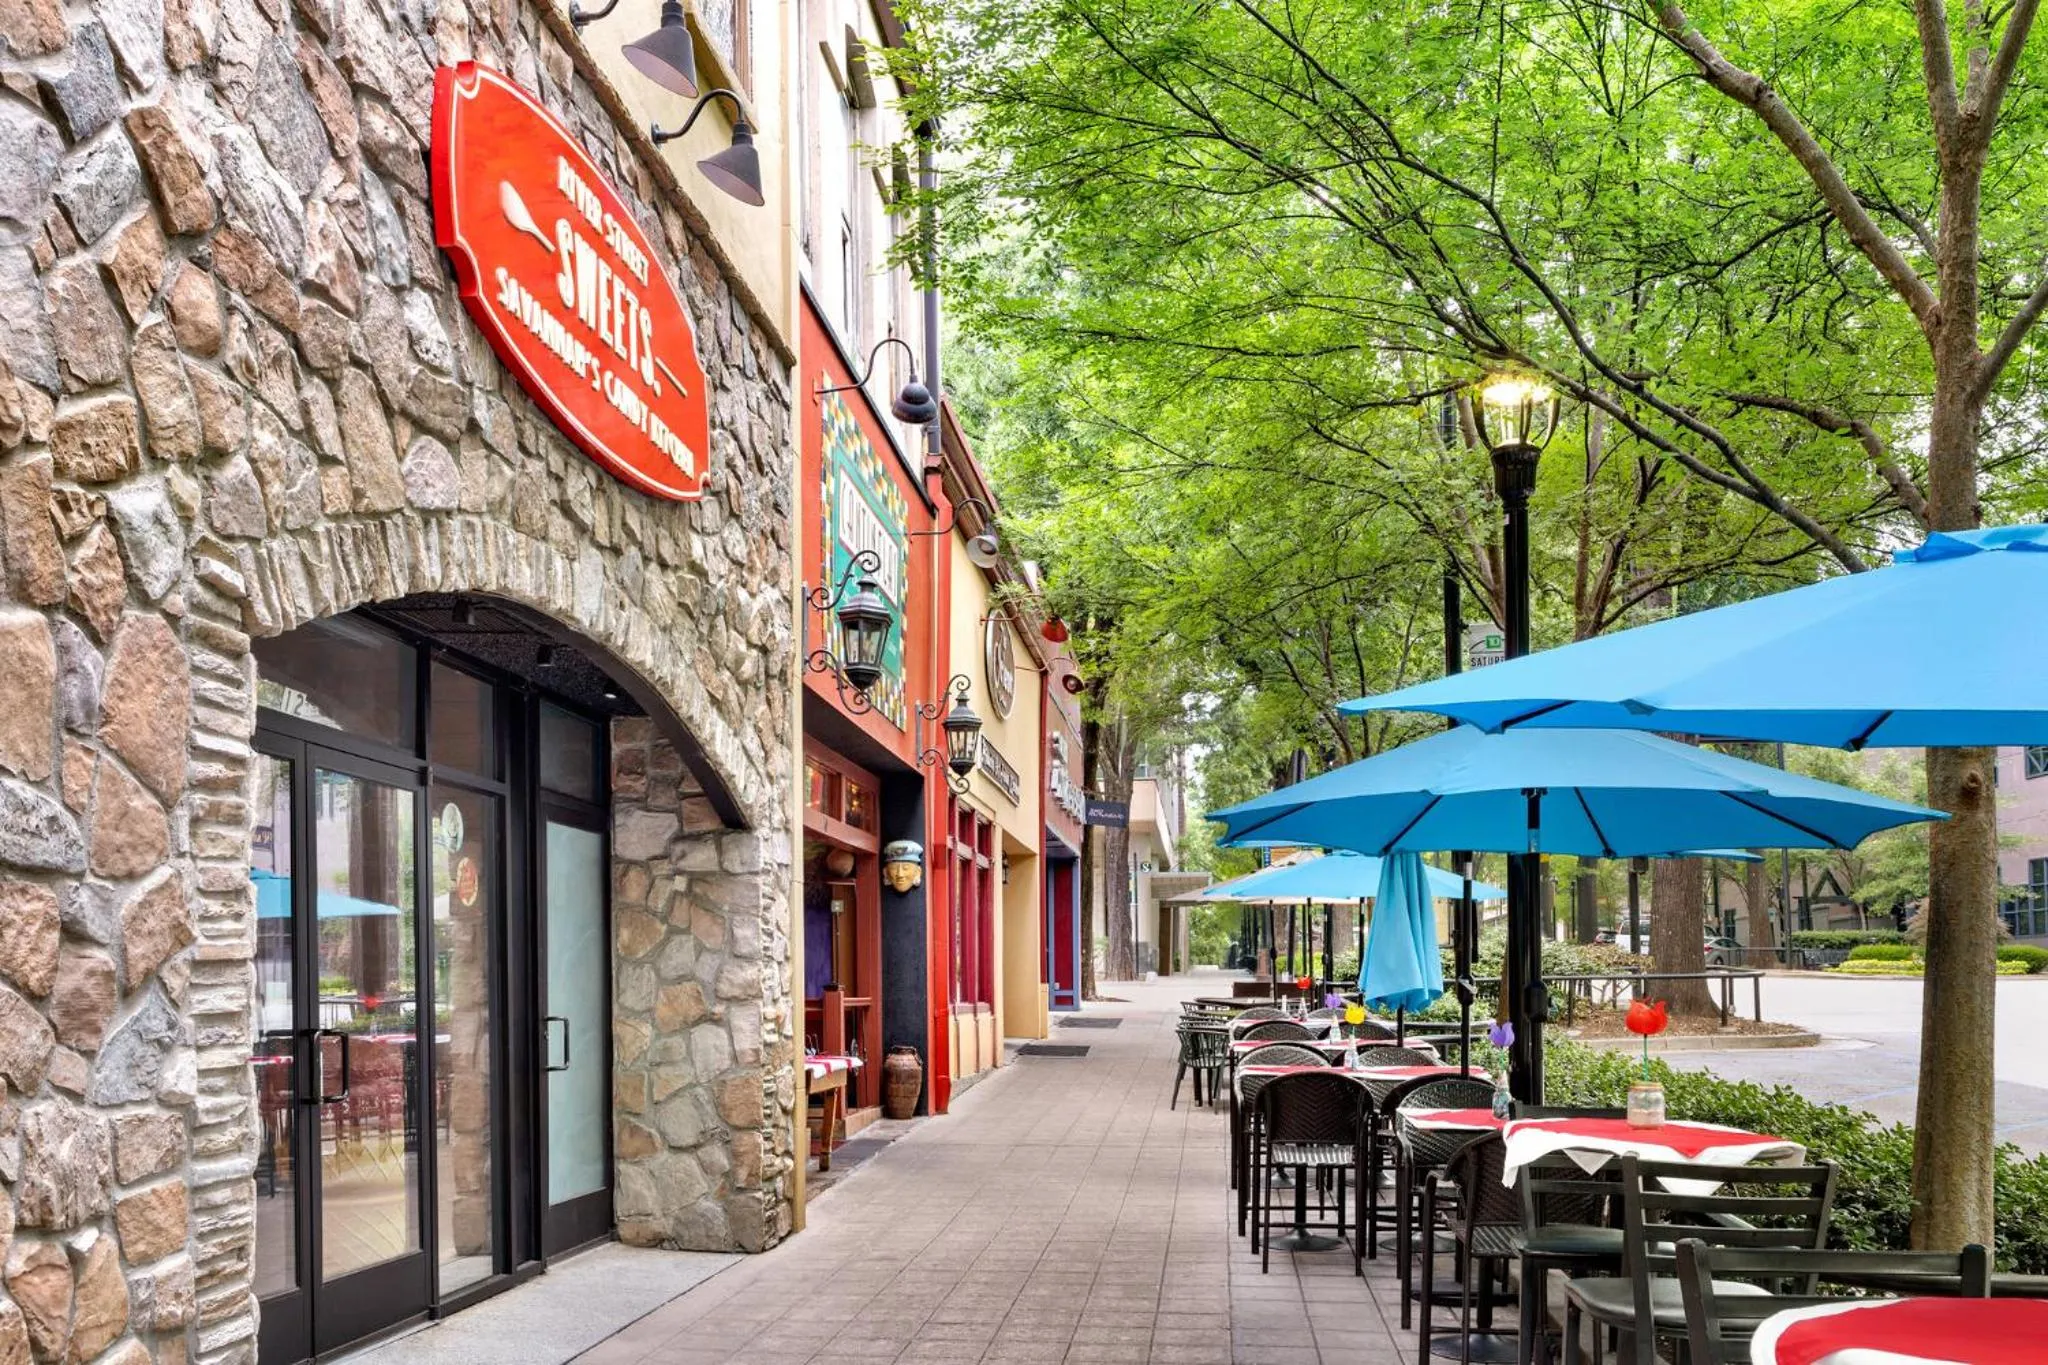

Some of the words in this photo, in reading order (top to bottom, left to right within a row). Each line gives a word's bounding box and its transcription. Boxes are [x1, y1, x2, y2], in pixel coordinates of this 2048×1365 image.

[558, 155, 603, 235] RIVER
[604, 213, 648, 287] STREET
[496, 267, 601, 391] SAVANNAH'S
[604, 370, 648, 432] CANDY
[651, 412, 694, 480] KITCHEN
